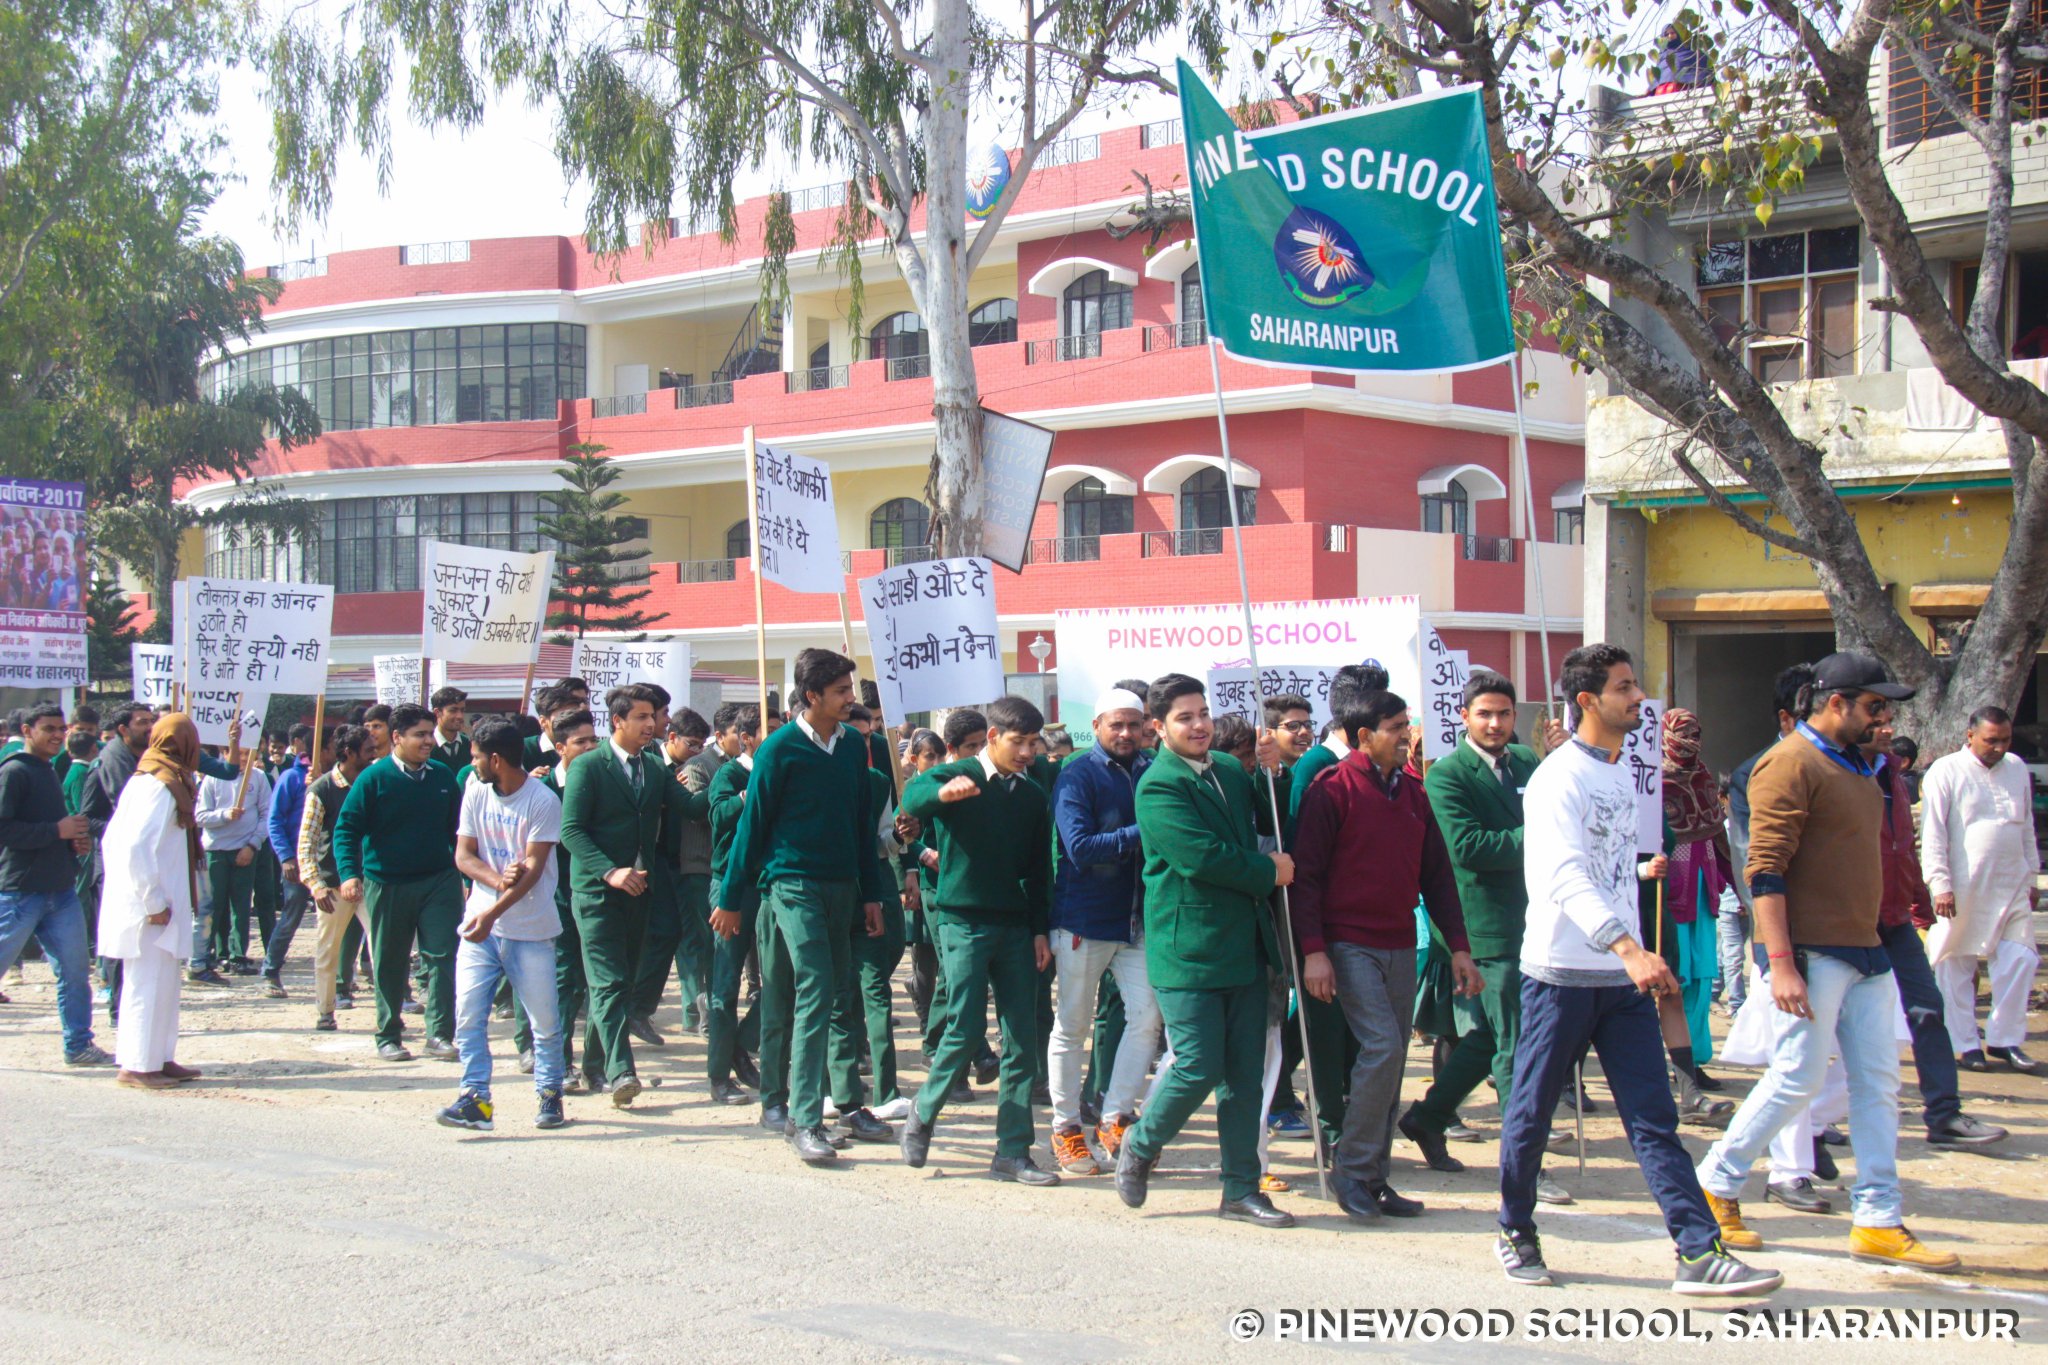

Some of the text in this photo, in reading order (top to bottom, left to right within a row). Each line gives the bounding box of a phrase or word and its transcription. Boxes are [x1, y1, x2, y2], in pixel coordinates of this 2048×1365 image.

[1195, 130, 1485, 228] PINED SCHOOL
[1250, 313, 1400, 354] SAHARANPUR
[496, 562, 519, 595] की
[923, 562, 967, 599] और
[968, 559, 988, 597] दे
[196, 581, 241, 608] लोकतंत्र
[243, 591, 266, 608] का
[436, 589, 478, 614] पुकार
[232, 609, 248, 633] हो
[452, 612, 484, 640] डालो
[1107, 621, 1357, 649] PINEWOOD SCHOOL
[196, 633, 217, 656] फिर
[221, 633, 242, 656] वोट
[579, 644, 667, 668] लोकतंत्र का यह
[899, 633, 940, 670] कभी
[958, 625, 997, 660] देना
[36, 666, 87, 685] सहारनपुर
[246, 658, 267, 681] हो
[1216, 680, 1248, 707] सुबह
[1286, 670, 1313, 698] वोट
